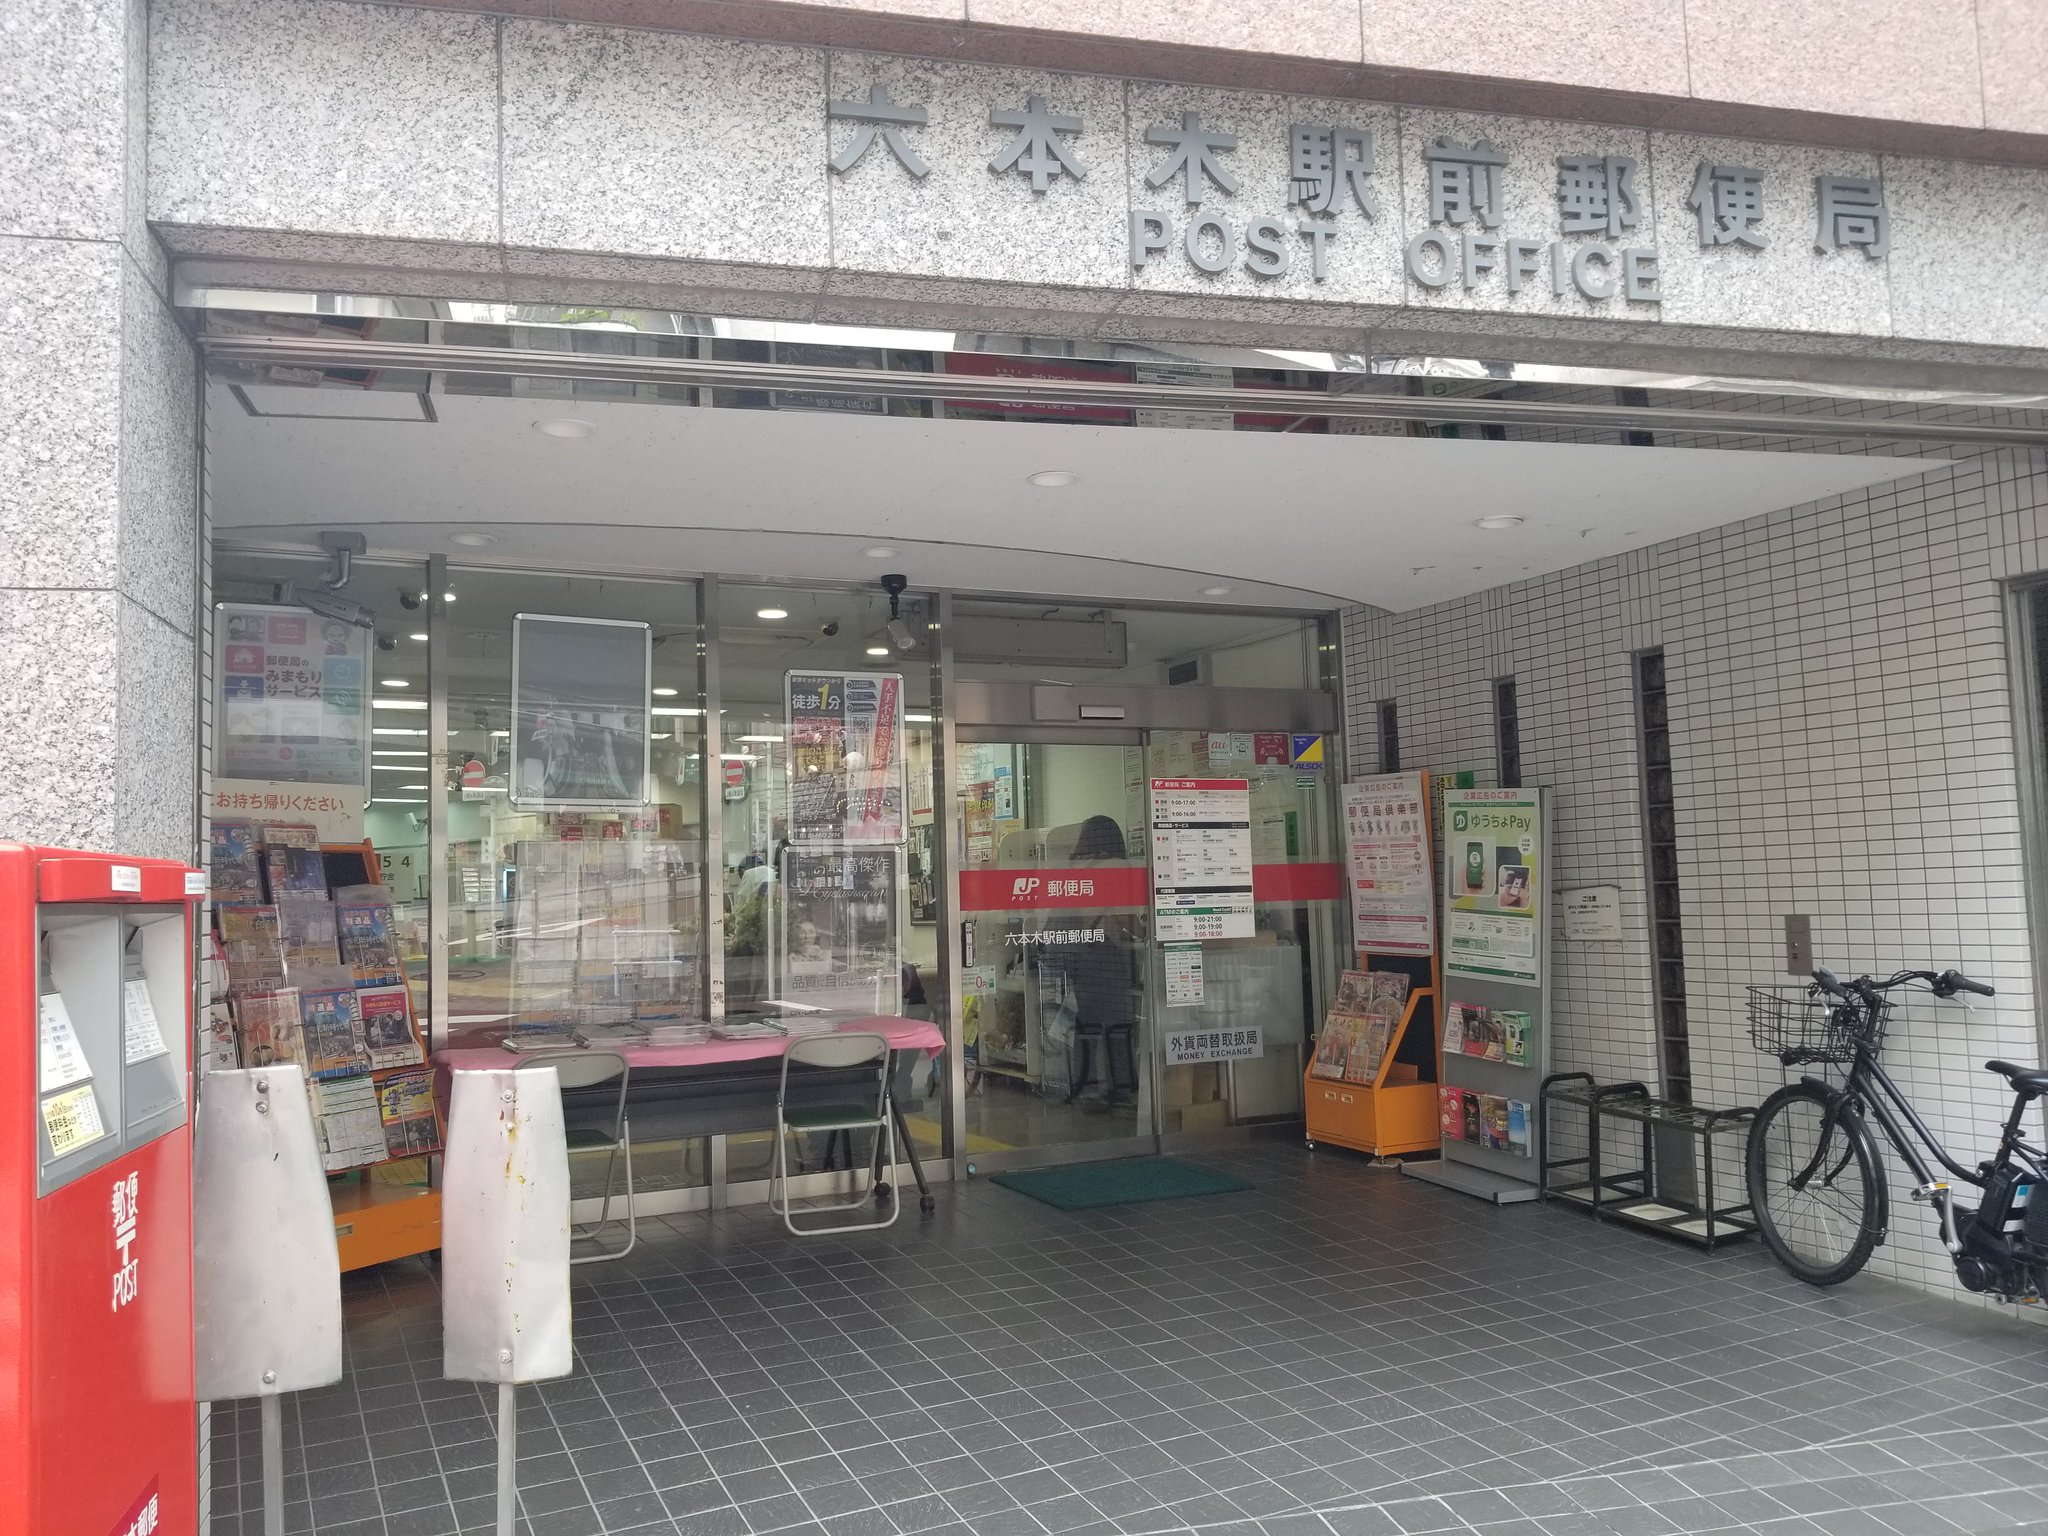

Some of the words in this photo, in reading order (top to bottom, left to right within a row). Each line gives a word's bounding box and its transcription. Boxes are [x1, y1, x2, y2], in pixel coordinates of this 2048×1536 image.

[829, 84, 1891, 260] 六本木駅前郵便局
[1131, 210, 1337, 282] POST
[1405, 229, 1663, 303] OFFICE
[265, 670, 321, 684] みまもり
[265, 685, 321, 698] サービス
[792, 683, 841, 711] 徒歩1分
[1464, 791, 1518, 800] 企業広告のご案内
[1471, 814, 1531, 832] ゆうちょPay
[1048, 880, 1094, 897] 郵便局
[1005, 929, 1105, 946] 六本木駅前郵便局
[1171, 1031, 1257, 1052] 外貨両替取扱局
[1177, 1051, 1205, 1061] MONEY
[1211, 1047, 1253, 1058] EXCHANGE
[112, 1171, 138, 1228] 郵便
[112, 1259, 138, 1312] POST
